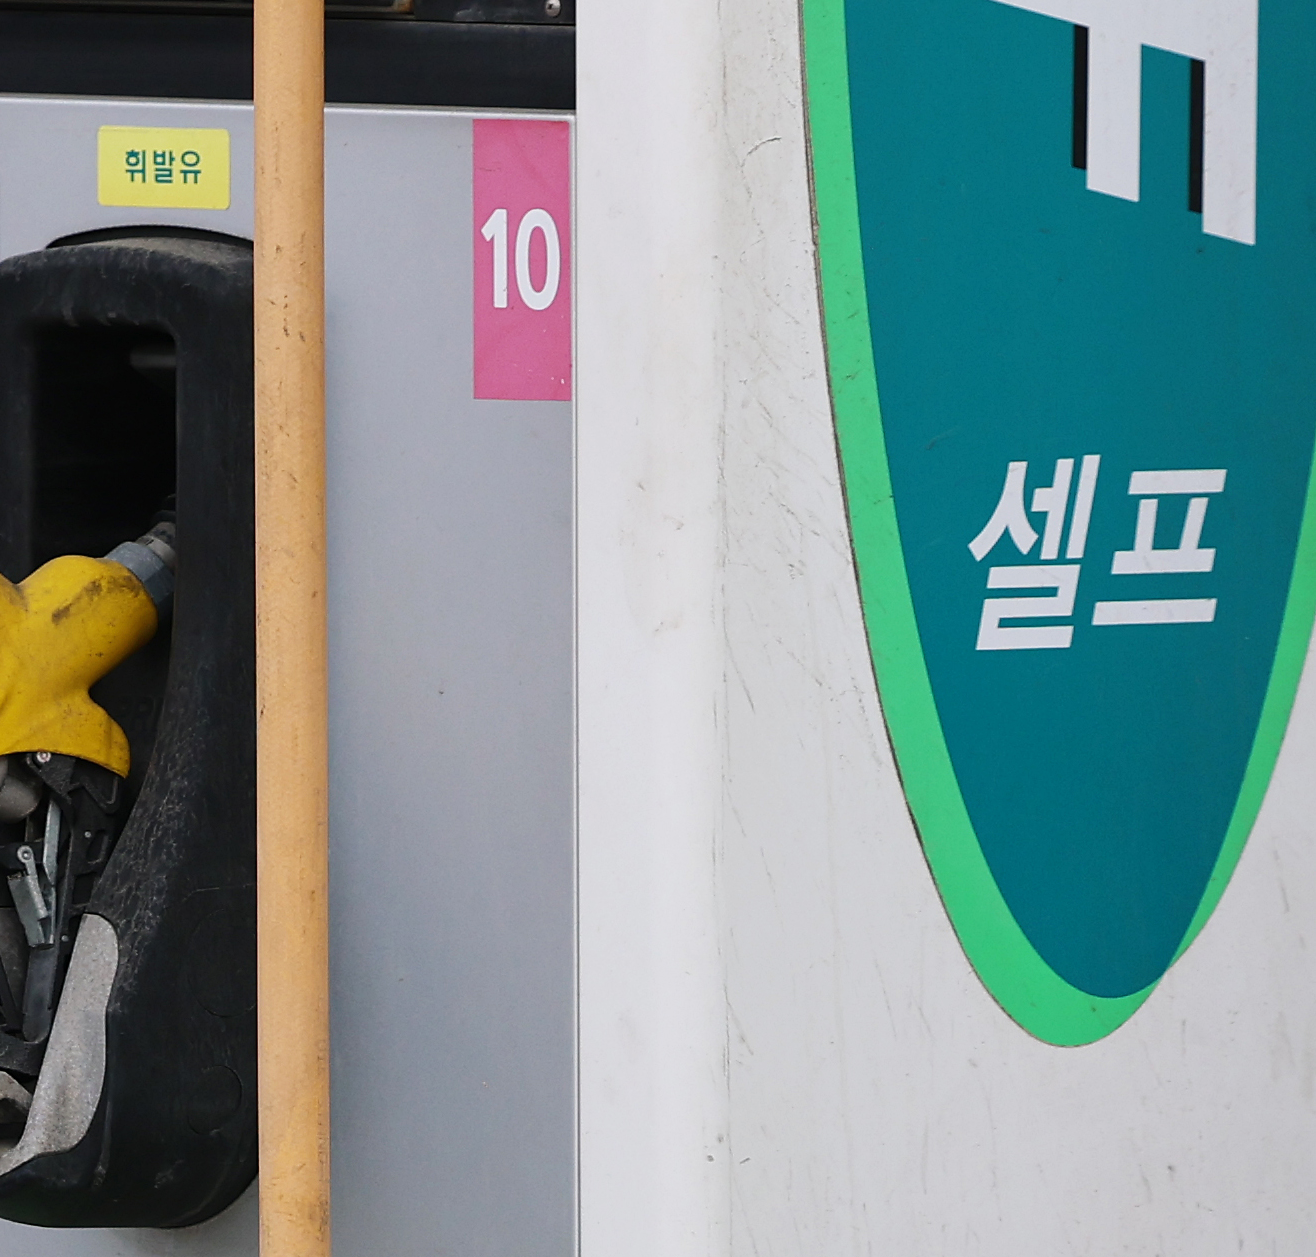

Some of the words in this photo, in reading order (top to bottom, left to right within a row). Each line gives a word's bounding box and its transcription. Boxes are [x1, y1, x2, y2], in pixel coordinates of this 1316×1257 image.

[124, 149, 202, 185] 휘발유
[480, 208, 561, 311] 10
[968, 453, 1227, 652] 셀프
